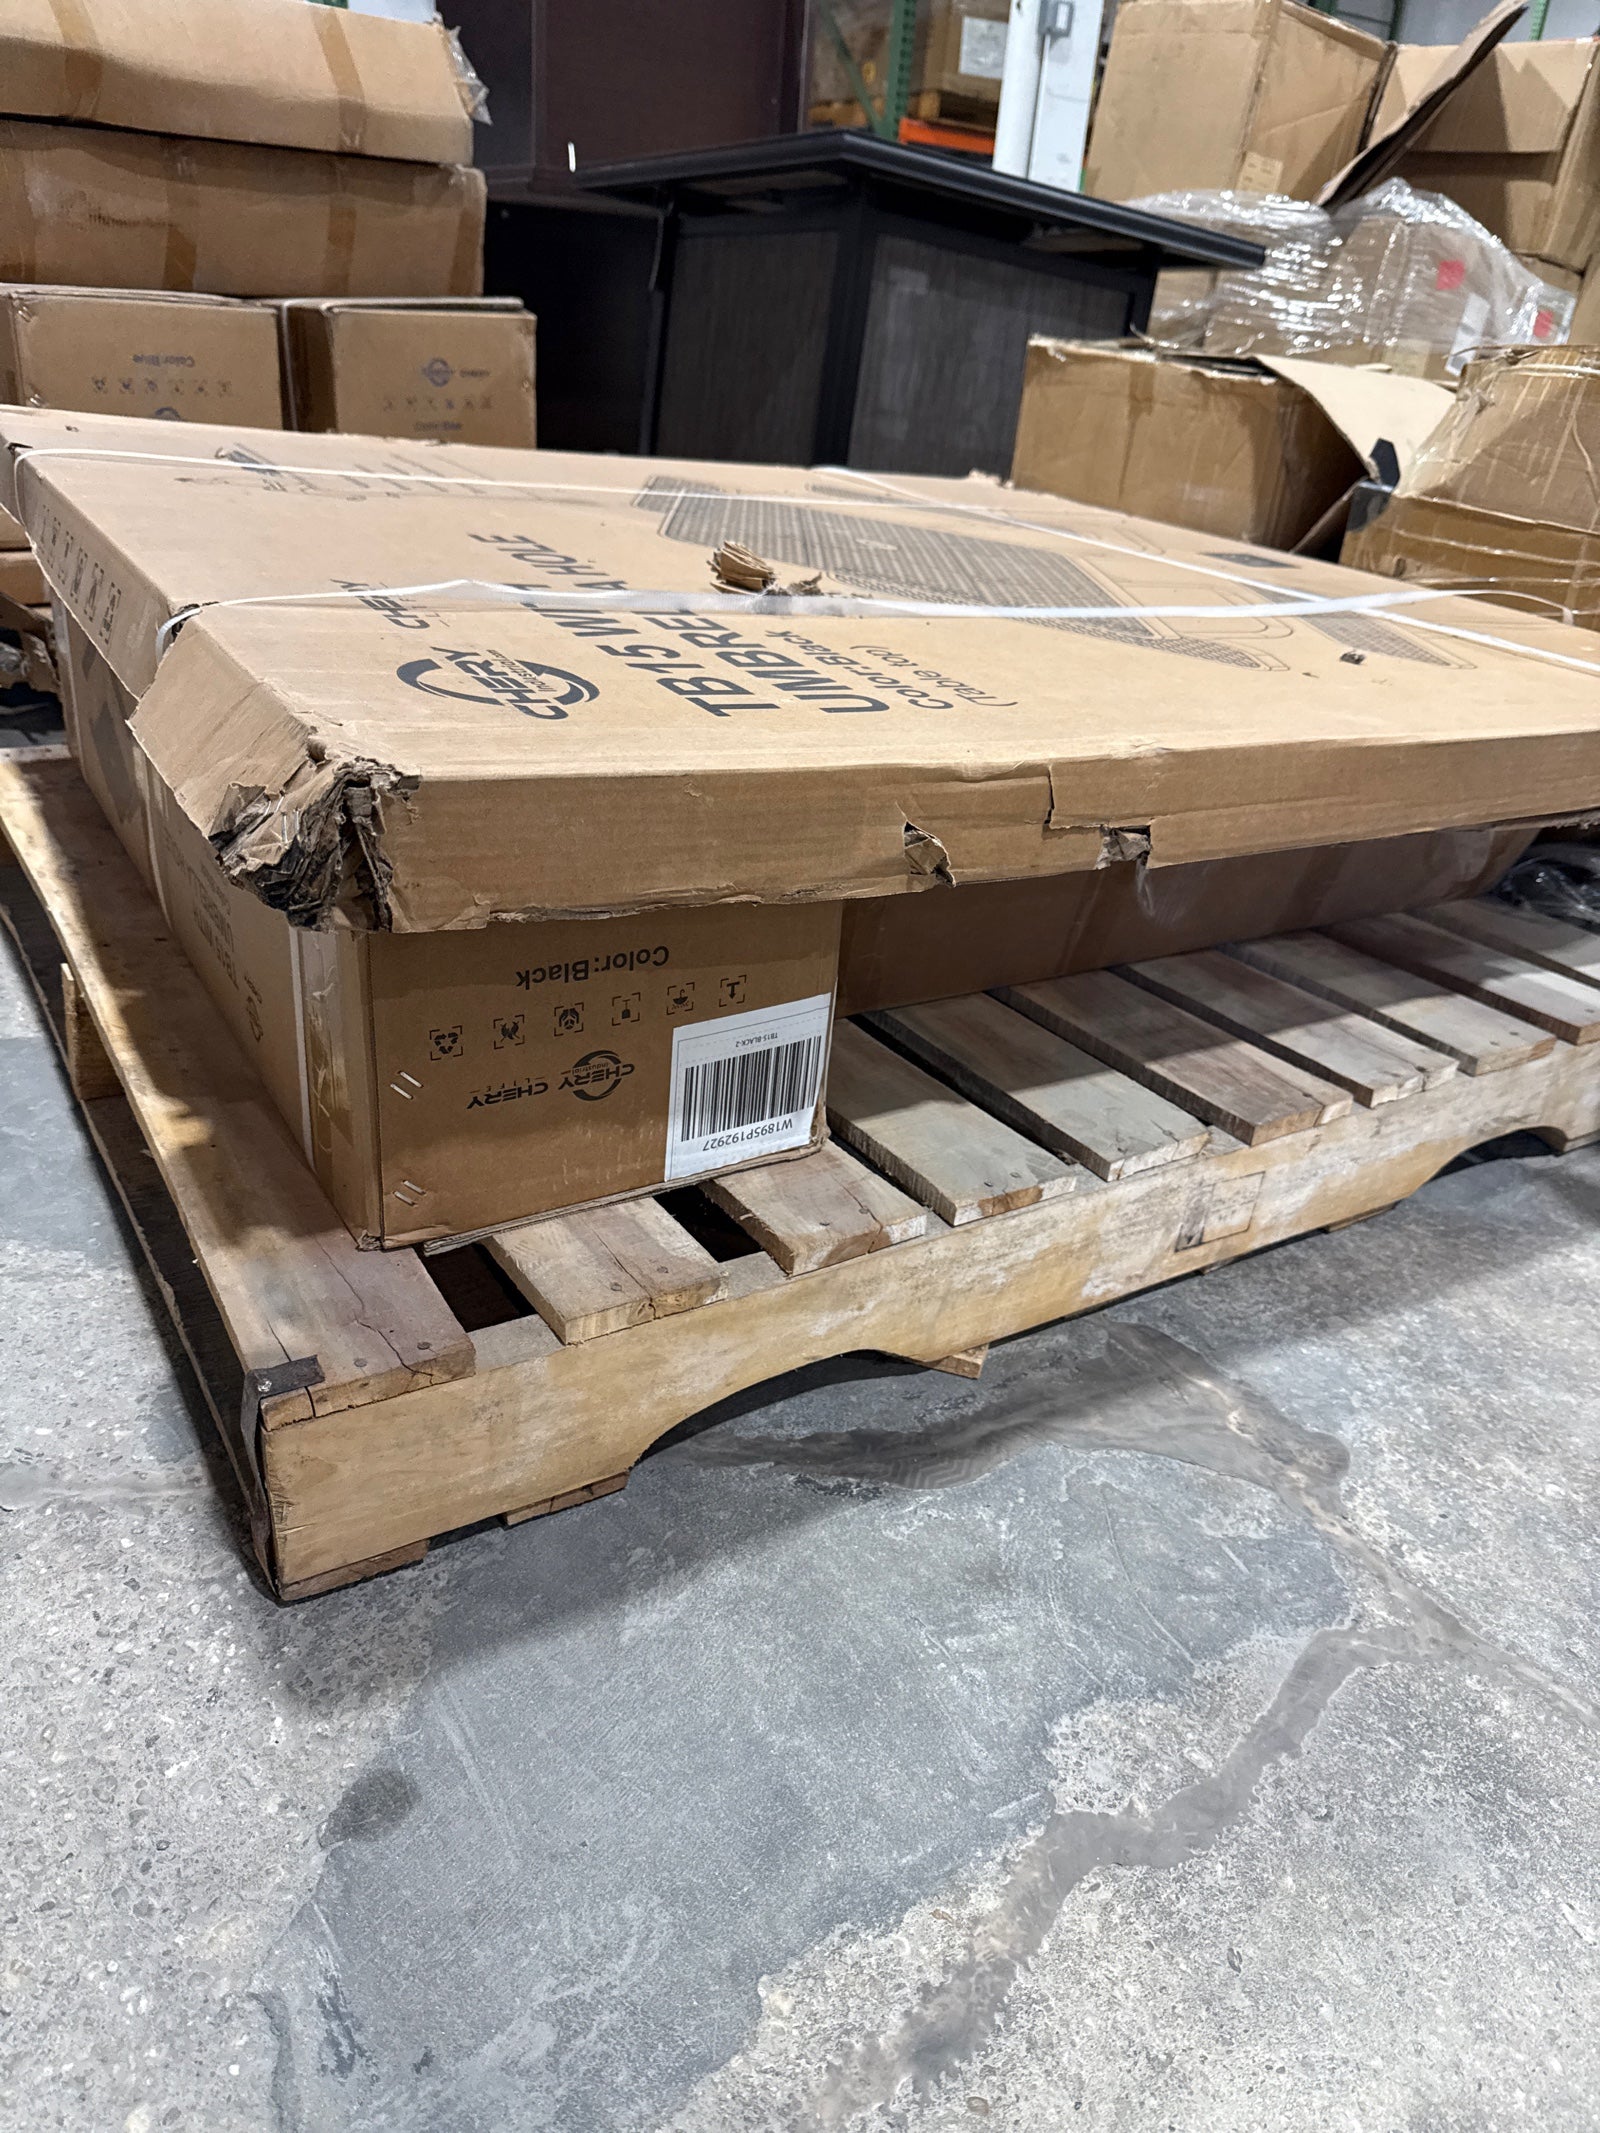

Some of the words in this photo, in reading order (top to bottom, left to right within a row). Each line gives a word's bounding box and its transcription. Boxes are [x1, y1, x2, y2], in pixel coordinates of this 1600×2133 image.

[467, 534, 610, 577] HOLE
[503, 583, 642, 638] WIH
[574, 580, 890, 714] UMBRELA
[849, 644, 920, 668] top)
[430, 646, 569, 720] CHERY
[596, 644, 781, 718] TB15
[764, 630, 955, 711] Color:Black
[913, 669, 1019, 707] (Table
[515, 945, 670, 990] Color:Black
[735, 1032, 779, 1048] TB15-BLACK-2
[466, 1081, 549, 1110] CHERY
[557, 1063, 636, 1091] CHERY
[703, 1118, 794, 1152] W1895P192927
